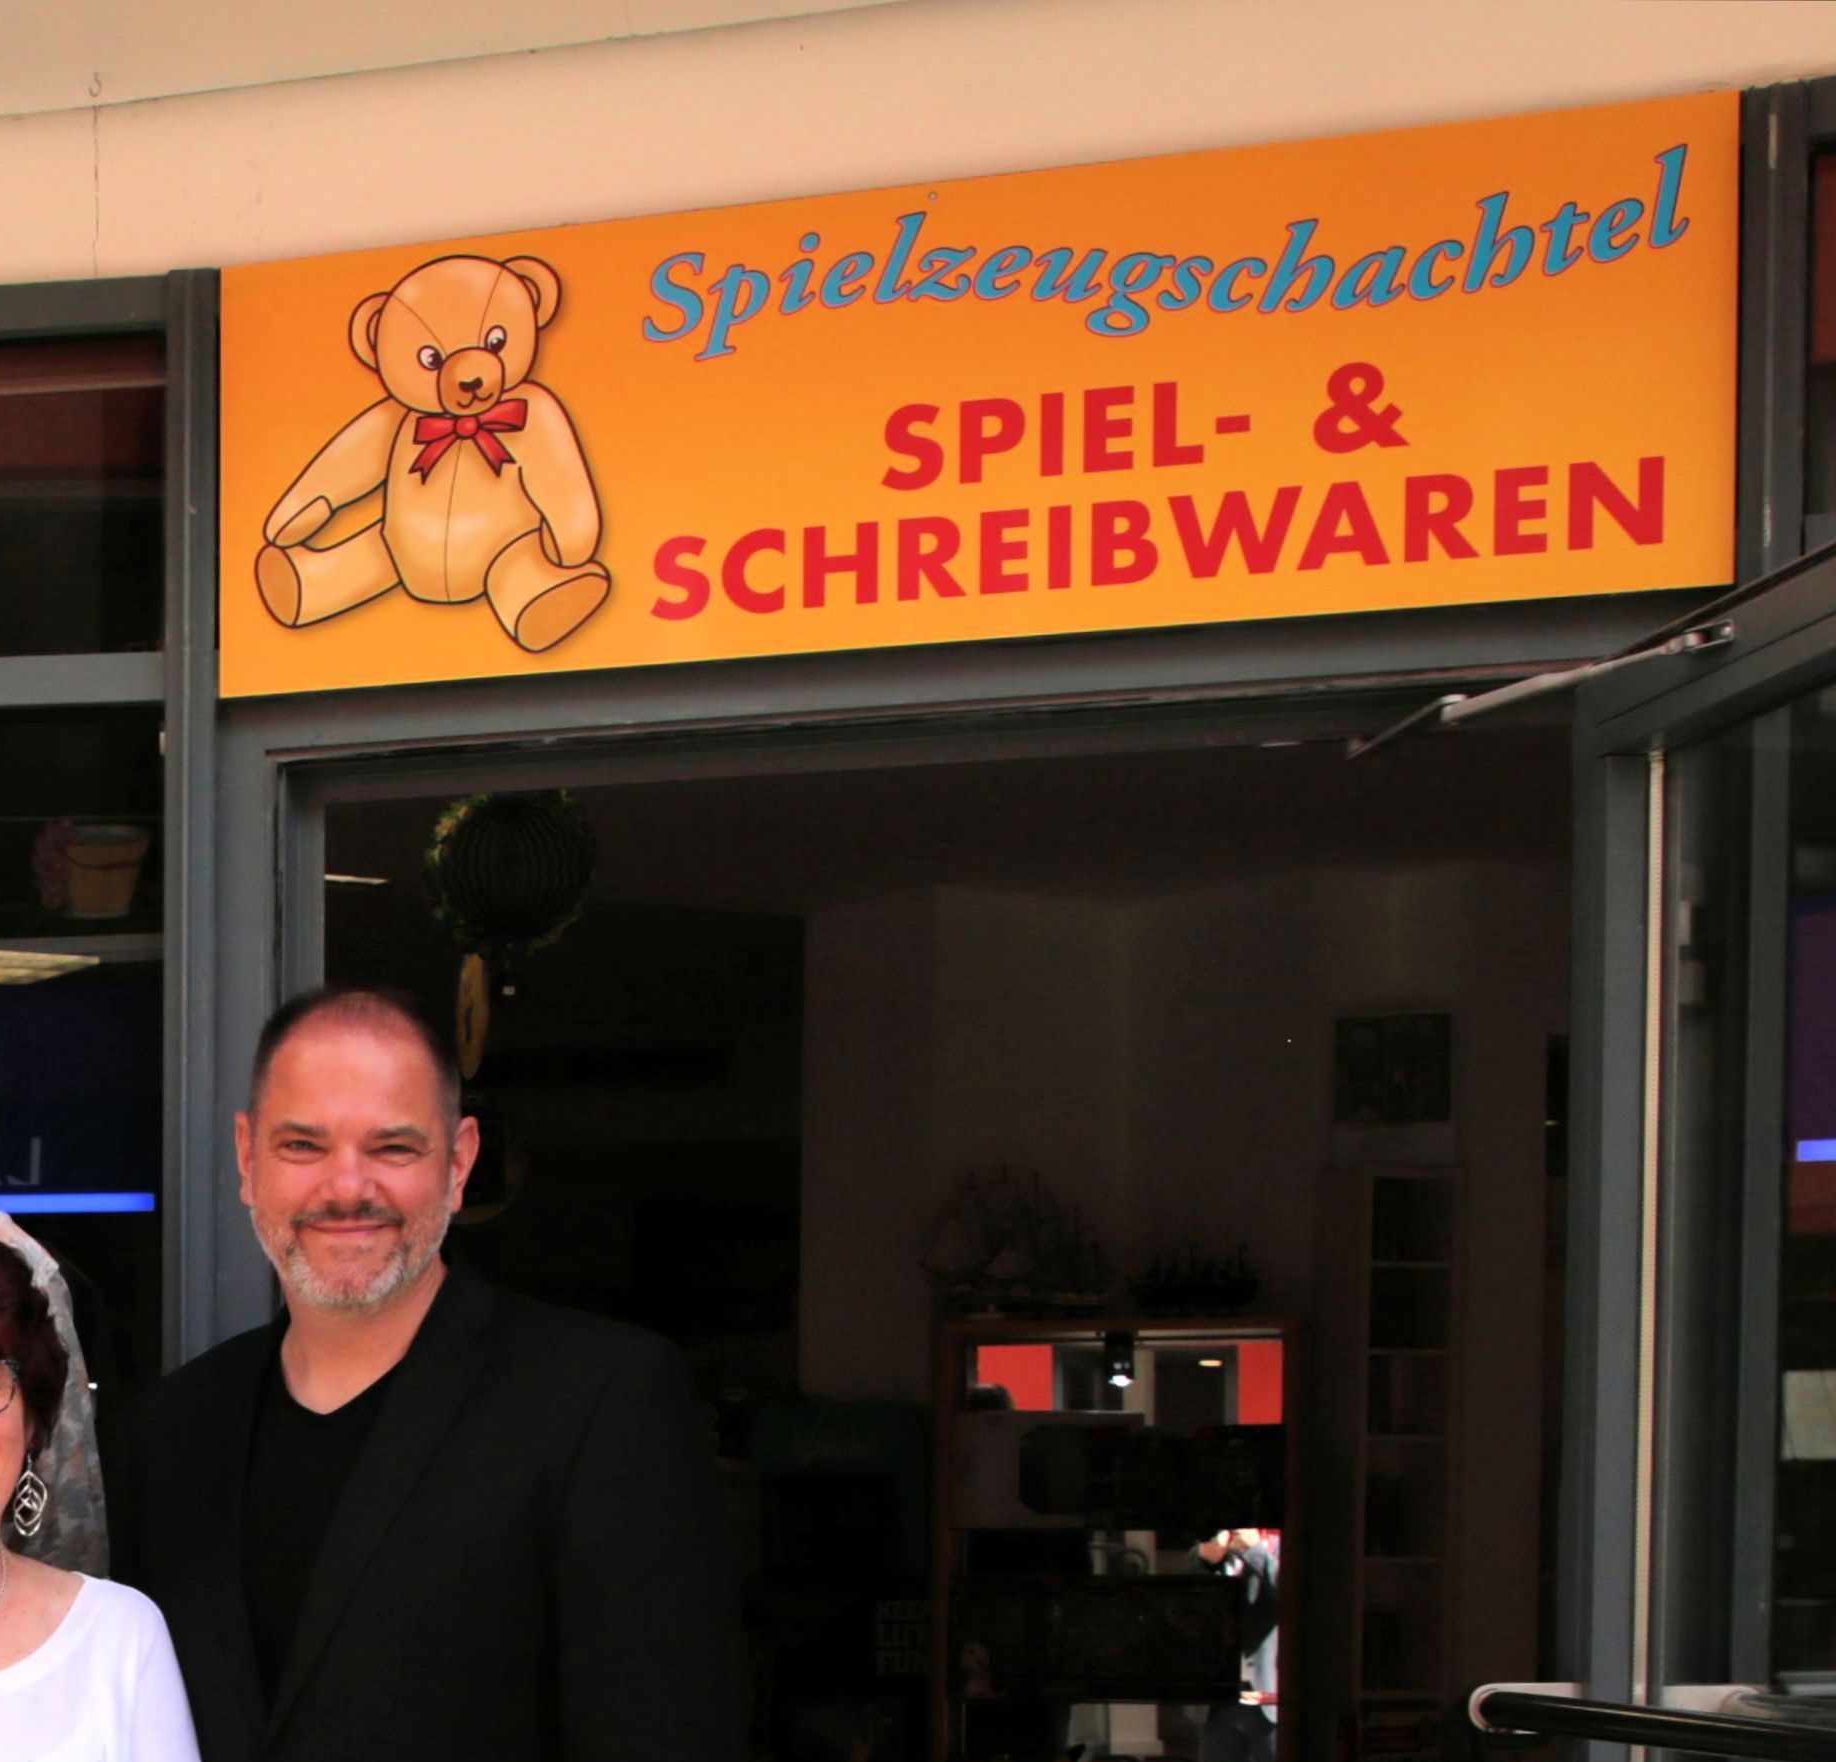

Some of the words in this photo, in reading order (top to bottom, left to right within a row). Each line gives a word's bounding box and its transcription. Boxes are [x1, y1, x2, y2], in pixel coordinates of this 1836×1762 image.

[644, 146, 1686, 358] Spielzeugschachtel
[882, 385, 1251, 491] SPIEL-
[1313, 362, 1408, 454] &
[652, 456, 1664, 620] SCHREIBWAREN
